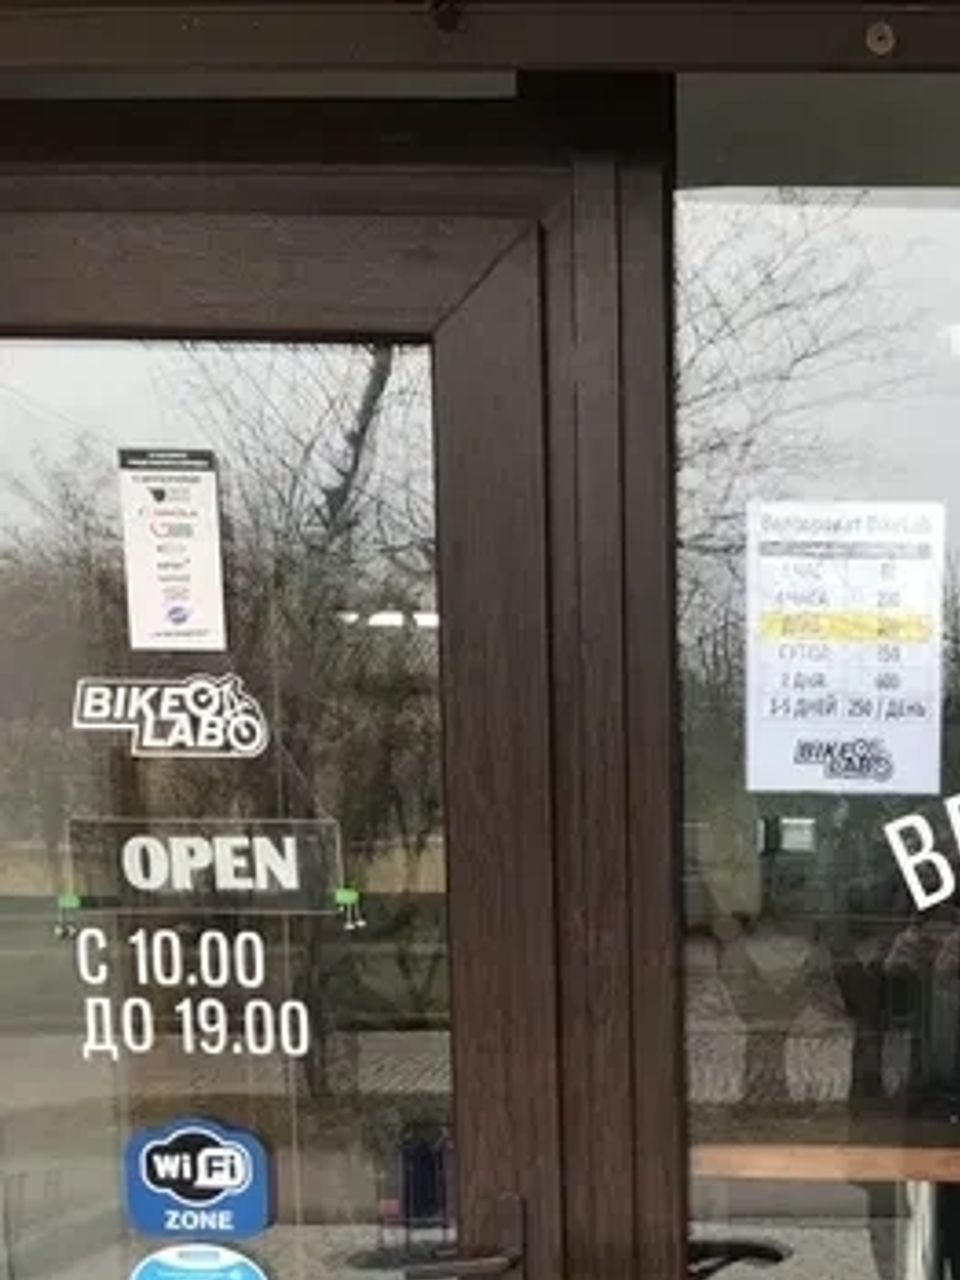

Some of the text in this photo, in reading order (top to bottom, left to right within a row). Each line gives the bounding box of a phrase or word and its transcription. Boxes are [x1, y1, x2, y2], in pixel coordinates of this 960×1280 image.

[121, 835, 300, 891] OPEN
[76, 926, 266, 990] С 10.00
[82, 996, 311, 1062] ДО 19.00
[163, 1209, 235, 1231] ZONE
